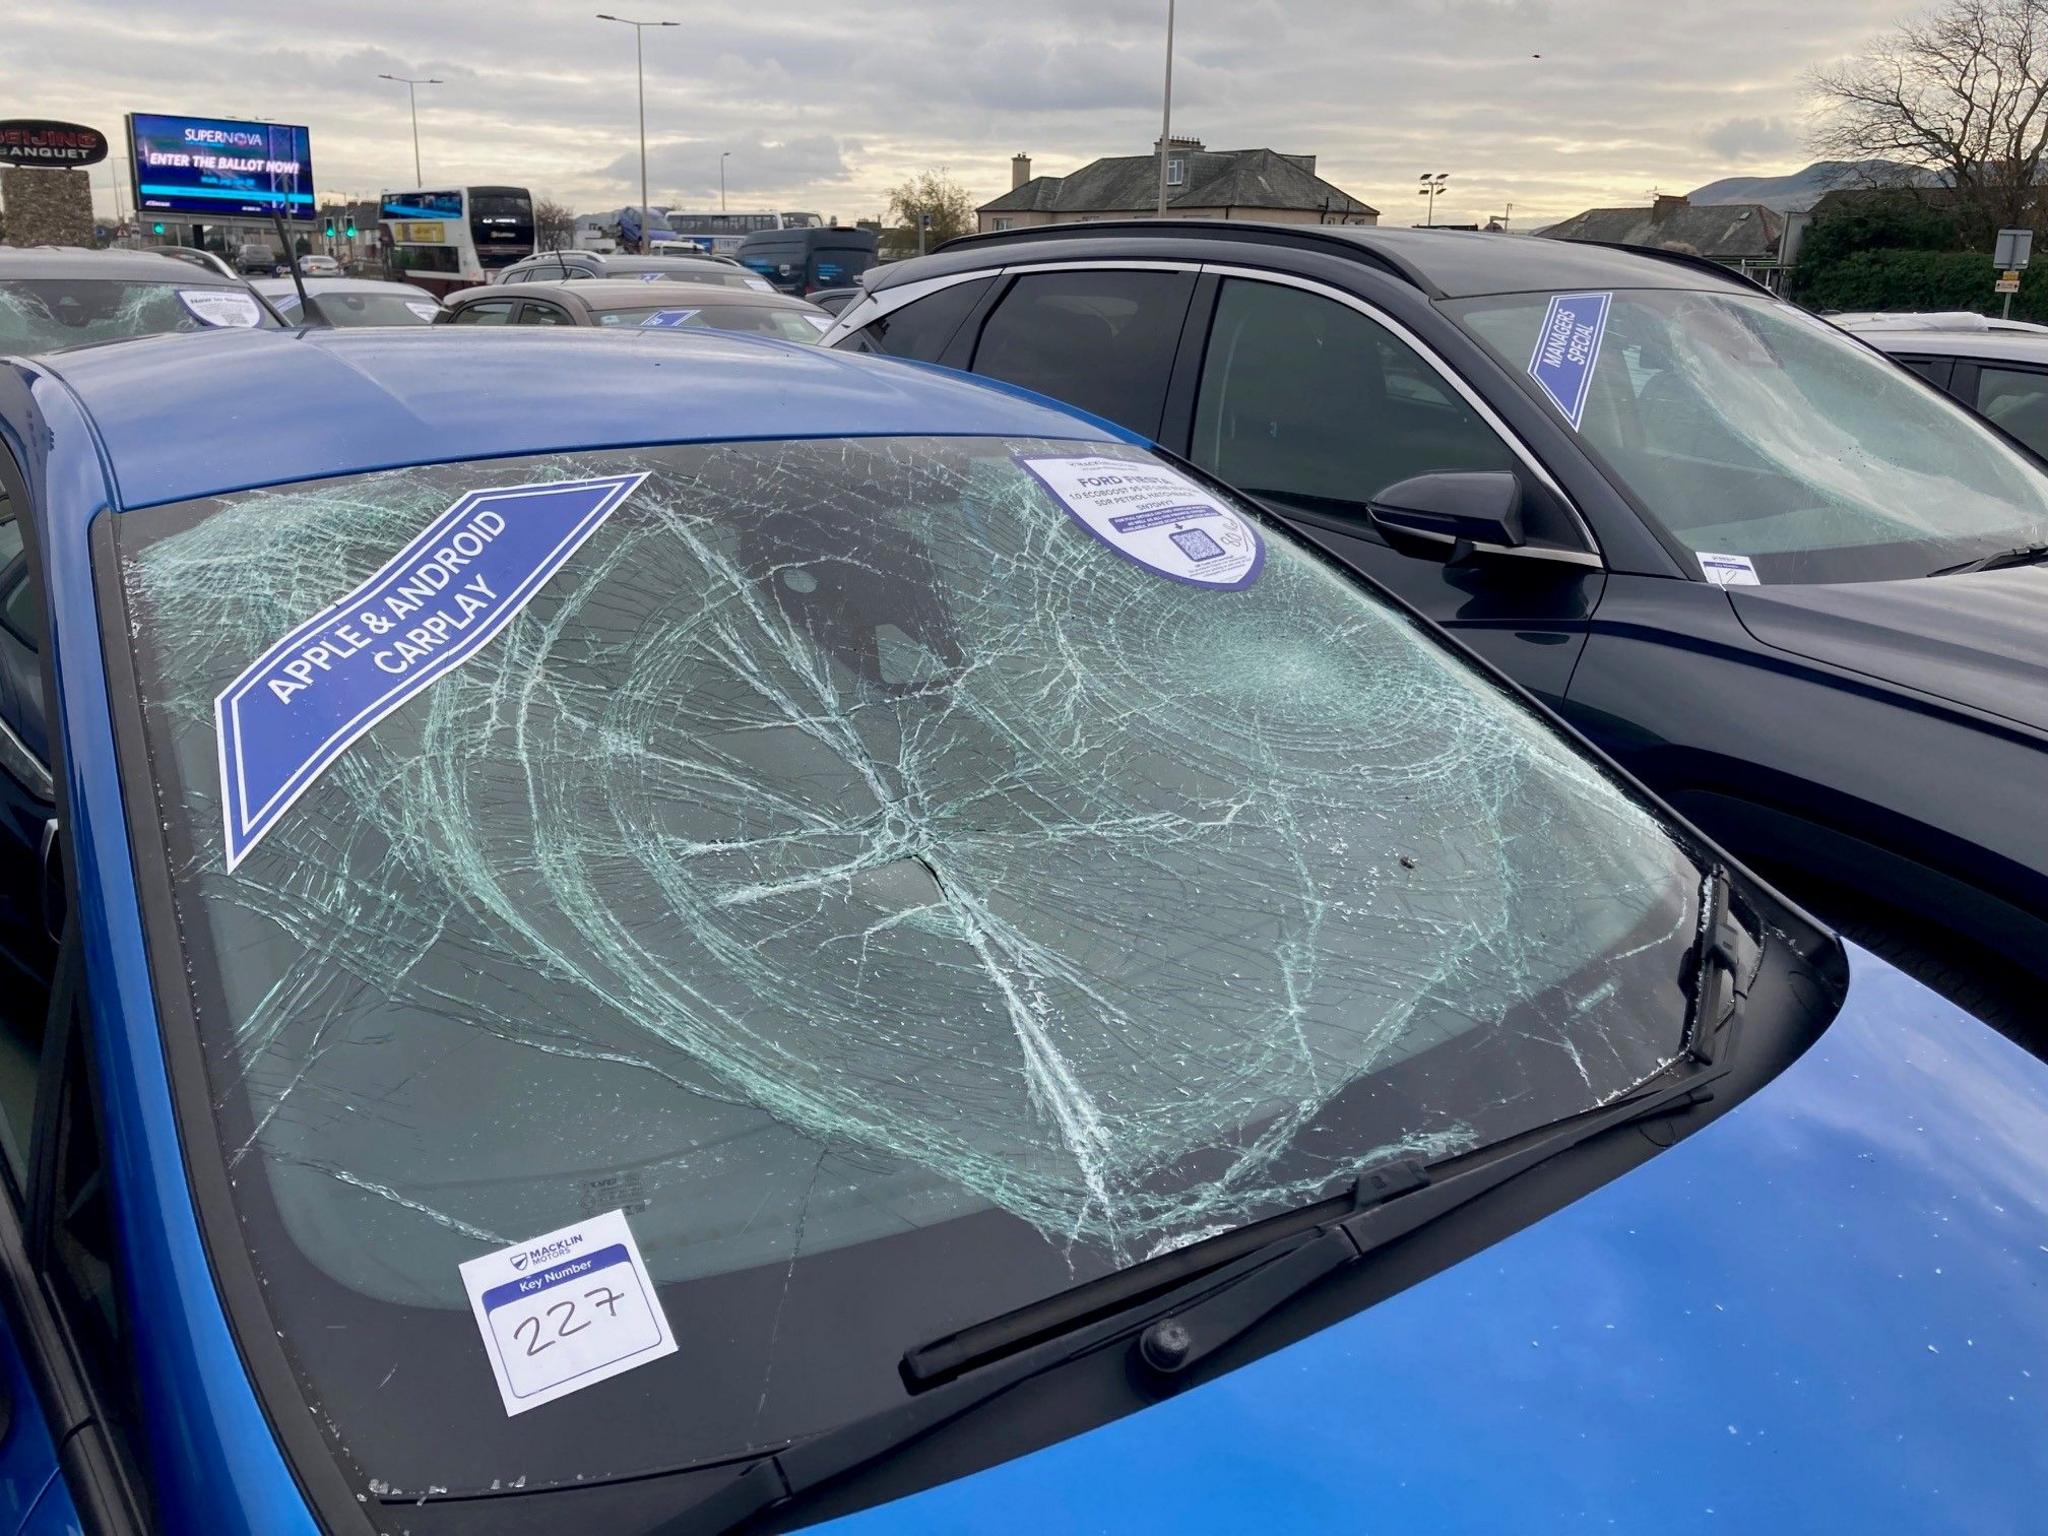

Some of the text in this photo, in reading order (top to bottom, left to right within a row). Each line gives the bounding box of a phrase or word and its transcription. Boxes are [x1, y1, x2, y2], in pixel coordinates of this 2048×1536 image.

[185, 128, 262, 146] SUPERNOVA
[150, 152, 299, 174] ENTER THE BALLOT NOW!
[1542, 308, 1576, 368] MANAGERS
[1567, 323, 1594, 366] SPECIAL
[1077, 475, 1123, 488] FORD
[267, 509, 506, 705] APPLE & ANDROID
[373, 573, 499, 674] CARPLAY
[529, 1234, 583, 1259] MACKLIN
[532, 1246, 571, 1265] MOTORS
[519, 1260, 592, 1292] Key Number
[513, 1287, 625, 1357] 227
